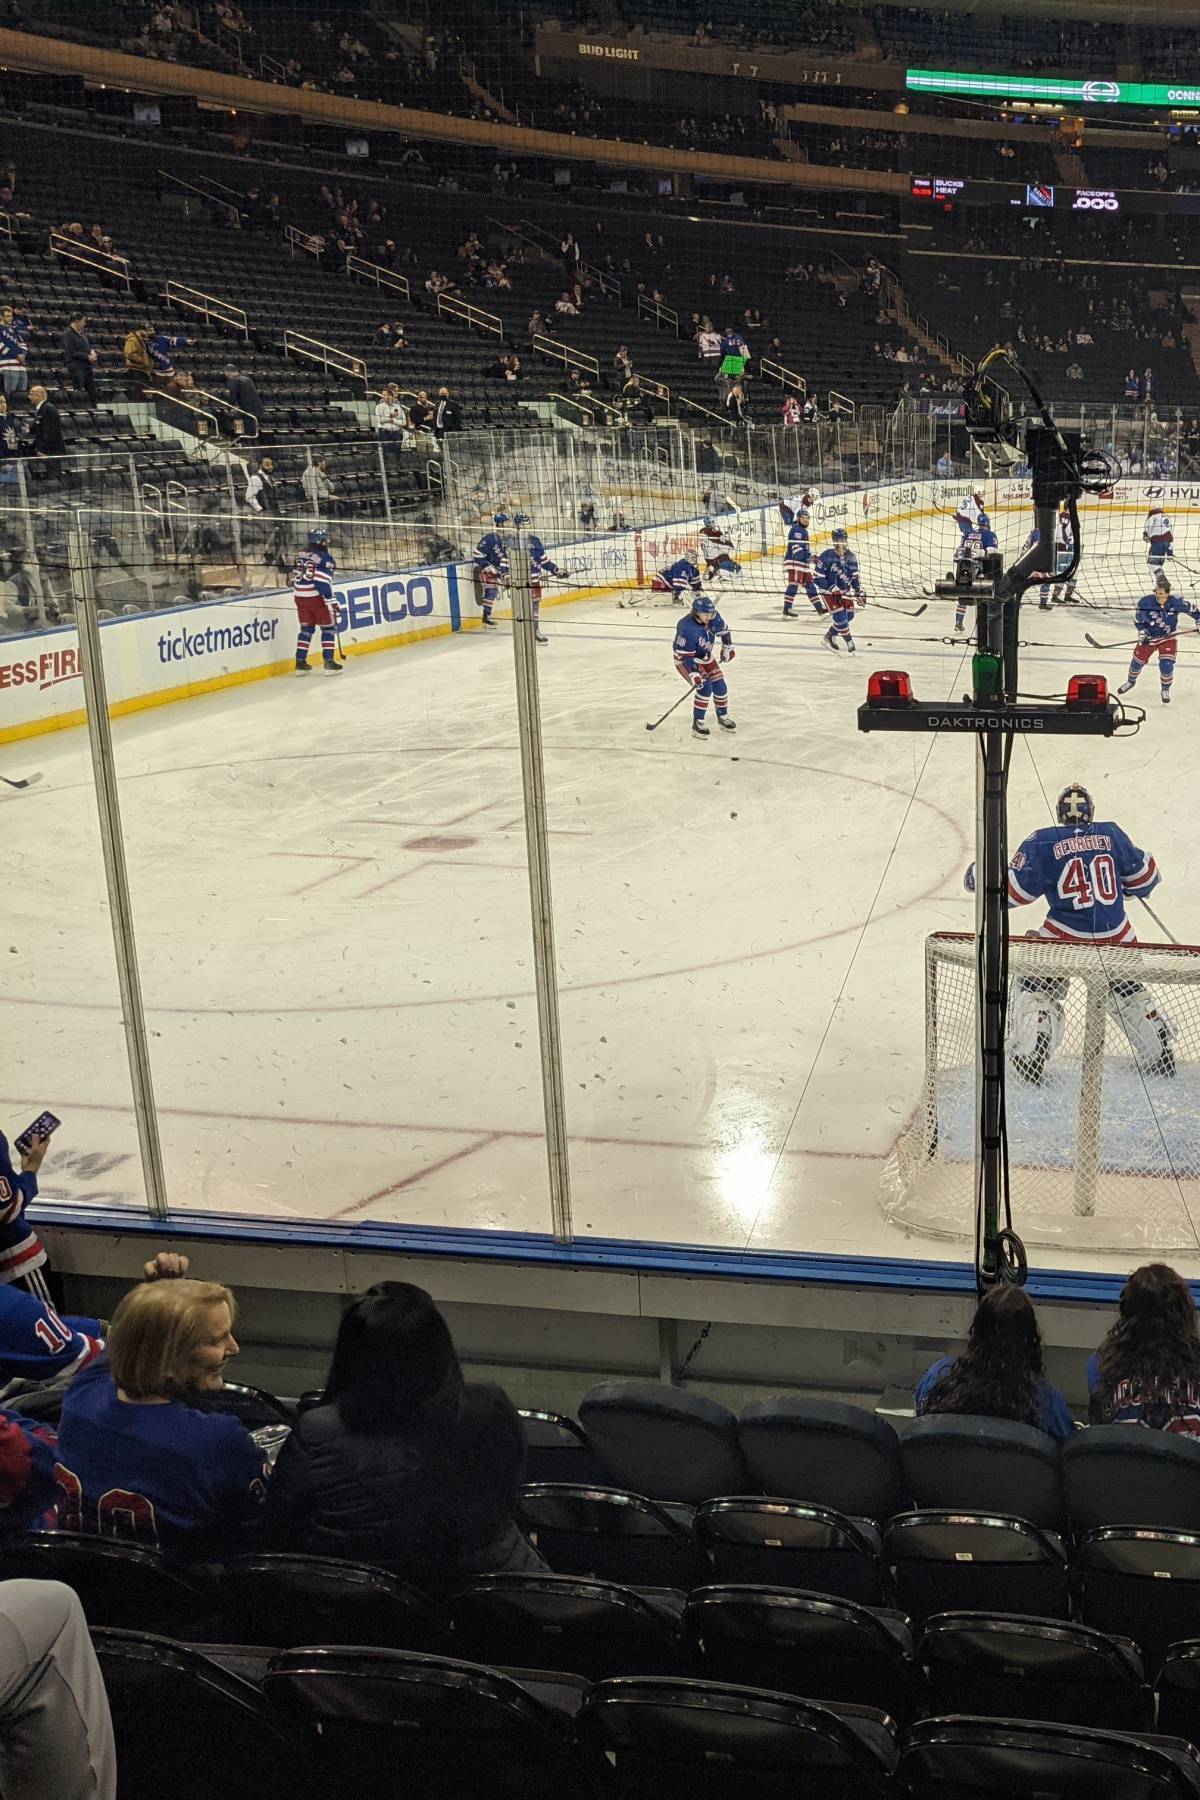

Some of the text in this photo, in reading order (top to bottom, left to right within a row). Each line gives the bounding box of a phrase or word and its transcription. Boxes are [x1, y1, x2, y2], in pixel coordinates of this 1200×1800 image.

[578, 43, 640, 60] BUD LIGHT
[936, 179, 965, 188] BUCKS
[936, 187, 957, 195] HEAT
[1076, 190, 1115, 198] FACEOFFS
[823, 502, 848, 518] LEXUS
[670, 530, 700, 555] DUNKI
[334, 577, 434, 633] GEICO
[158, 616, 279, 664] ticketmaster
[928, 716, 1044, 729] DAKTRONICS
[1053, 834, 1113, 860] GEORGIEV
[1057, 853, 1119, 911] 40
